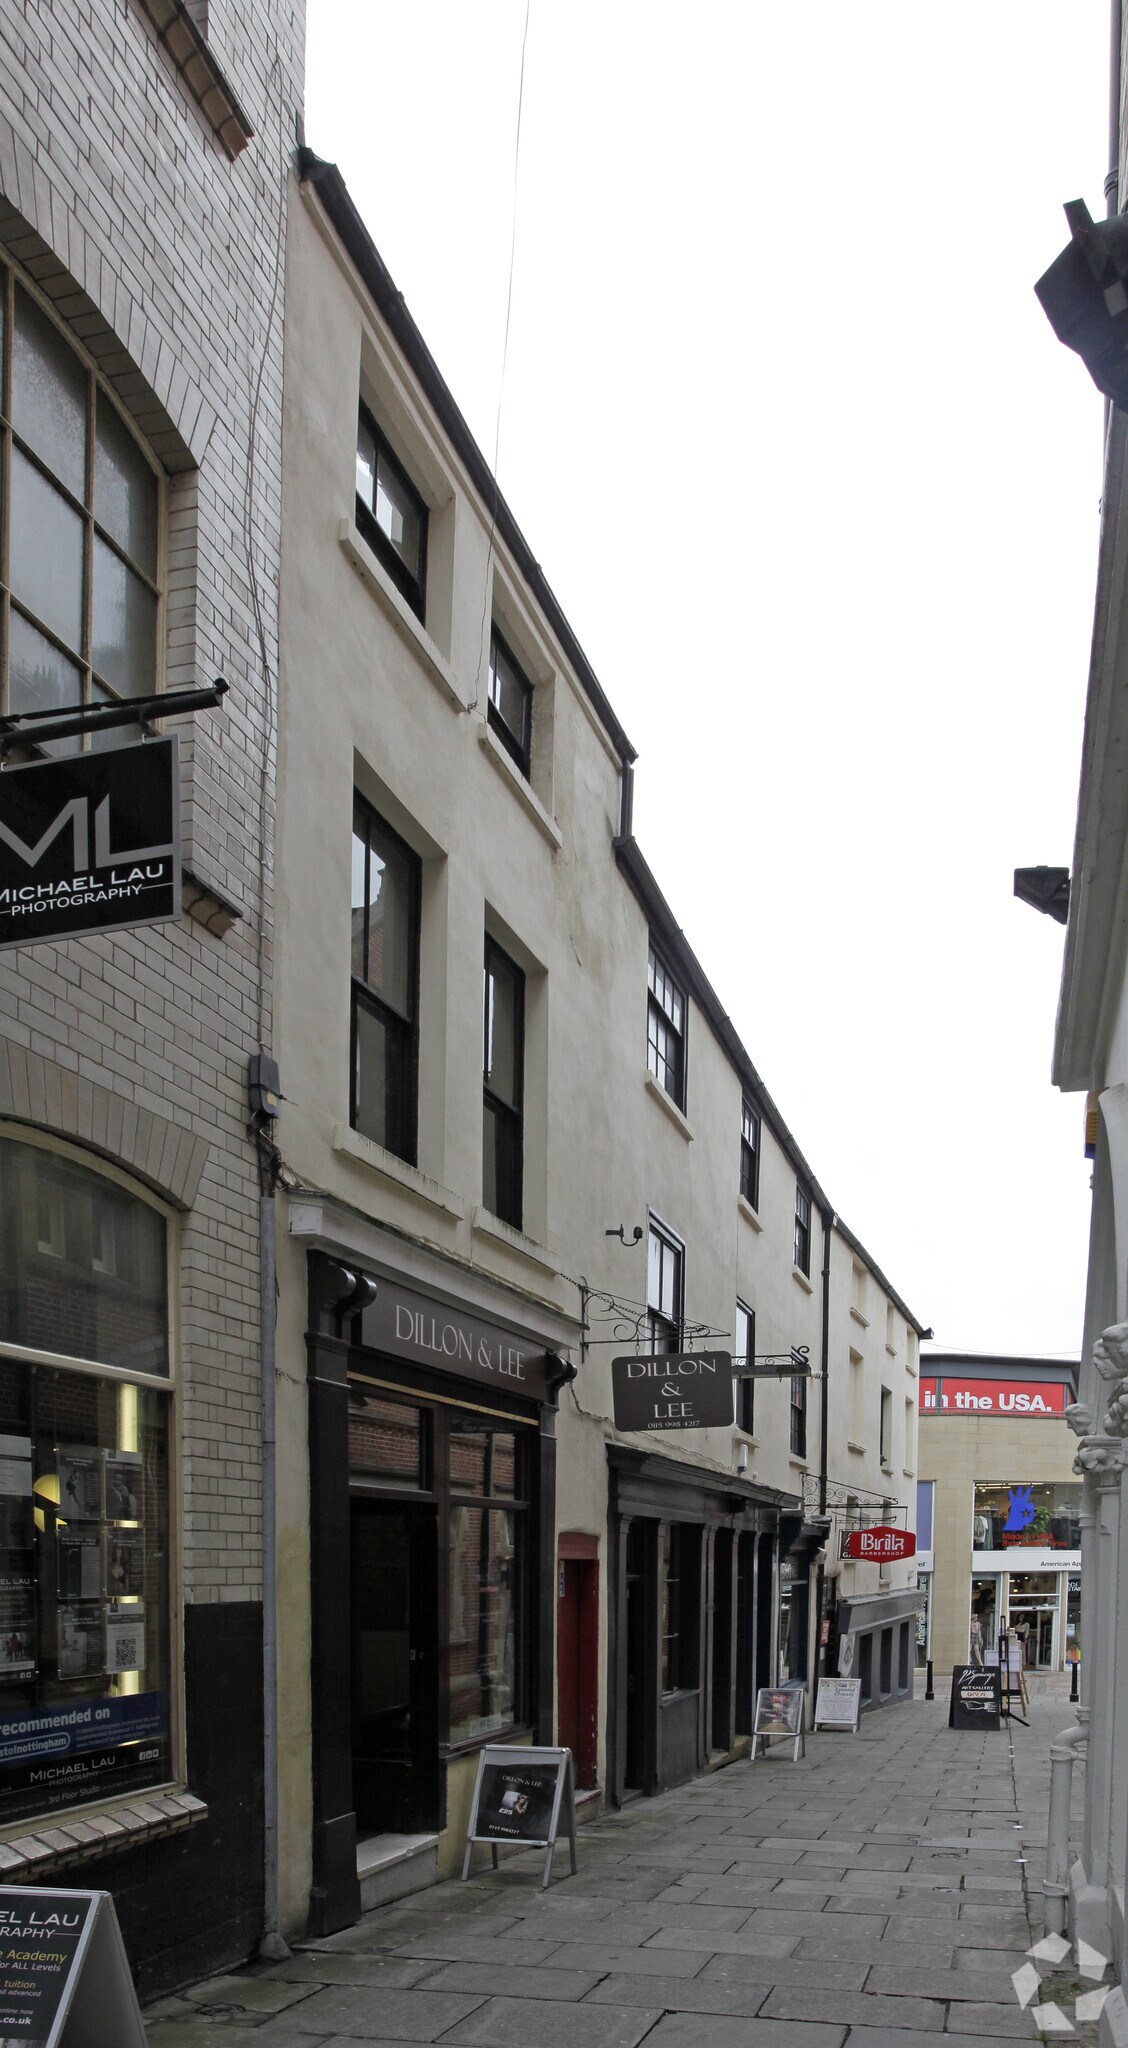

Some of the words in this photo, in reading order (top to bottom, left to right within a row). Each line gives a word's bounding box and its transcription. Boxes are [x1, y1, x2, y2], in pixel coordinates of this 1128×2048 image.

[111, 864, 164, 885] LAU
[11, 884, 143, 916] PHOTOGRAPHY
[395, 1304, 473, 1362] DILLON
[477, 1338, 494, 1370] &
[499, 1345, 525, 1380] LEE
[627, 1359, 717, 1378] DILLON
[661, 1382, 683, 1397] &
[924, 1391, 948, 1408] in
[954, 1392, 993, 1409] the
[998, 1393, 1052, 1412] USA.
[654, 1402, 694, 1419] LEE
[95, 1708, 110, 1720] on
[30, 1763, 89, 1783] MICHAEL
[91, 1756, 116, 1769] LAU
[48, 1771, 100, 1786] PHOTOGRAPHY
[48, 1795, 60, 1805] 3rd
[61, 1791, 79, 1801] Floor
[80, 1786, 101, 1797] Studio
[29, 1911, 80, 1927] LAU
[7, 1949, 67, 1964] Academy
[11, 1962, 28, 1970] ALL
[31, 1963, 61, 1972] Levels
[5, 1980, 36, 1989] tuition
[8, 1989, 42, 1997] advanced
